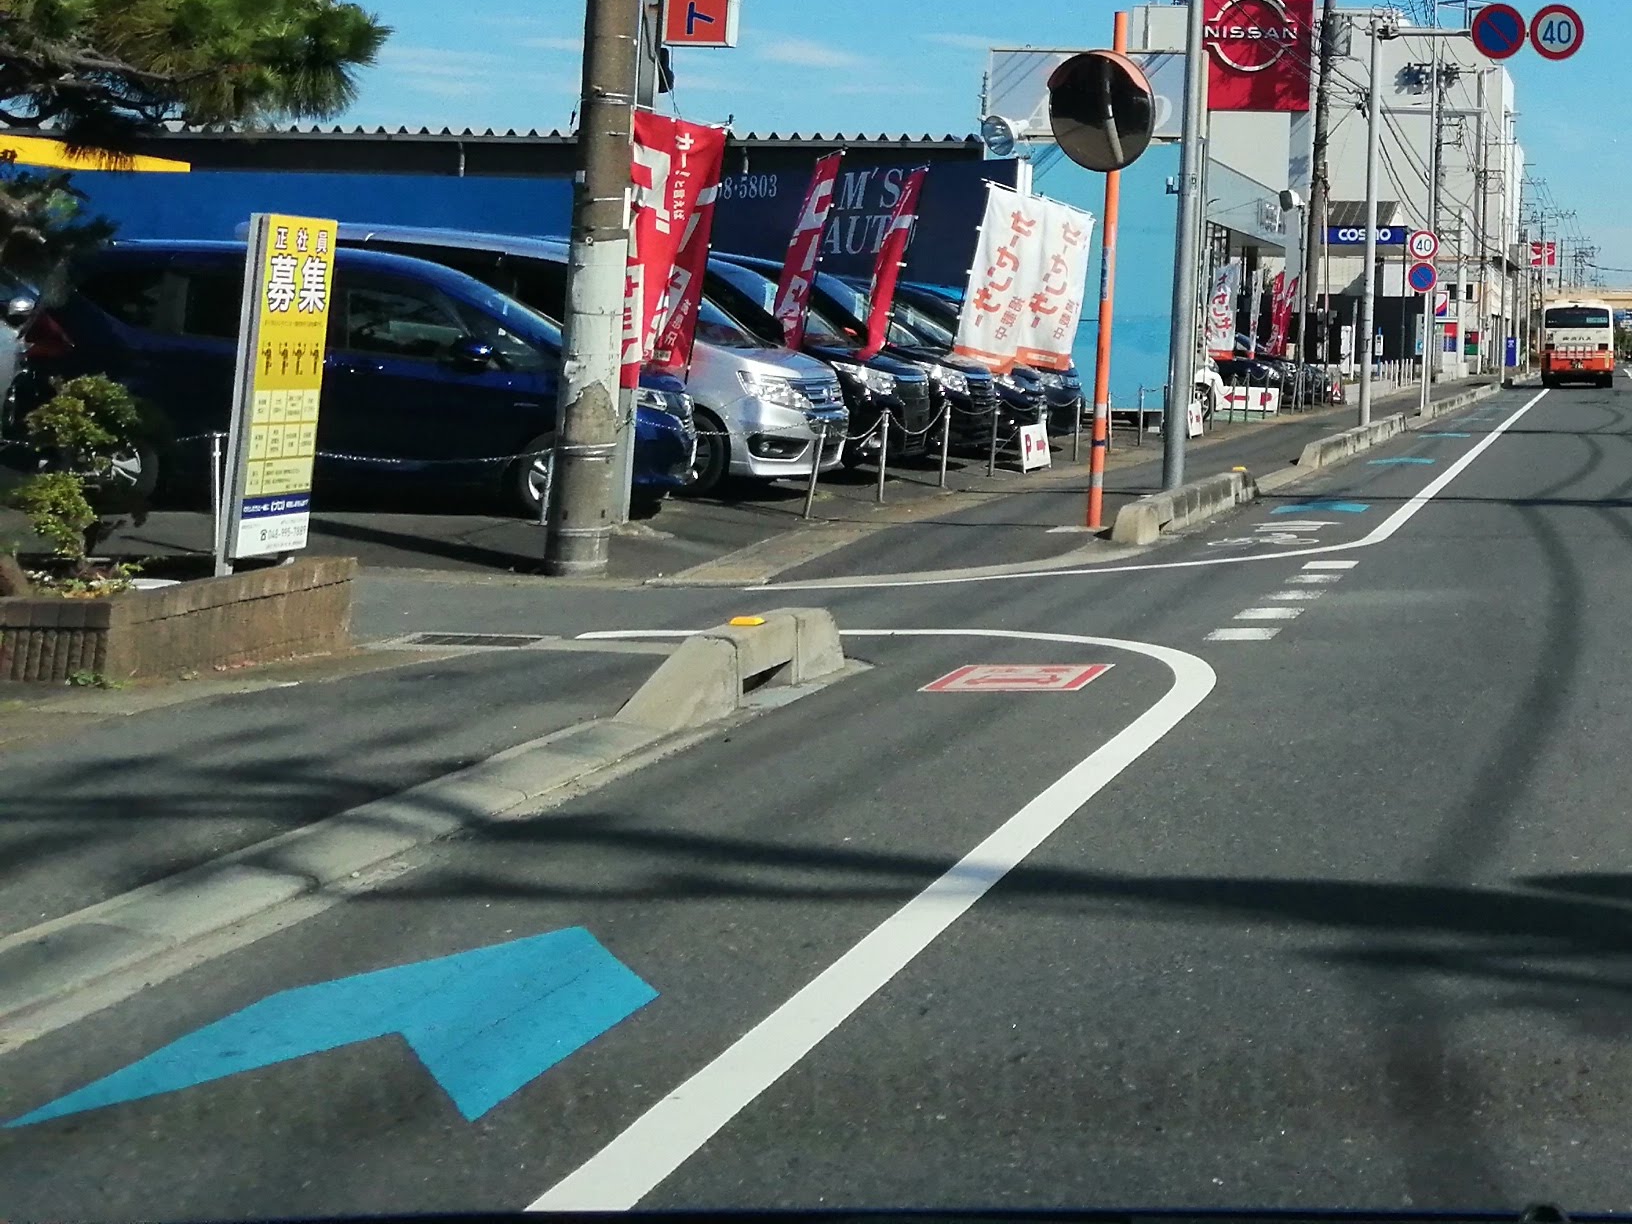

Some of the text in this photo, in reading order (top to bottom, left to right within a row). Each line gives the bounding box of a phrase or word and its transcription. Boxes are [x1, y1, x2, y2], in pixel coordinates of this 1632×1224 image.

[1204, 25, 1298, 40] NISSAN
[1542, 20, 1572, 44] 40
[275, 226, 329, 254] 正社員
[1338, 228, 1392, 241] COSO
[1415, 238, 1432, 252] 40
[267, 252, 328, 314] 募集
[1260, 392, 1272, 406] P
